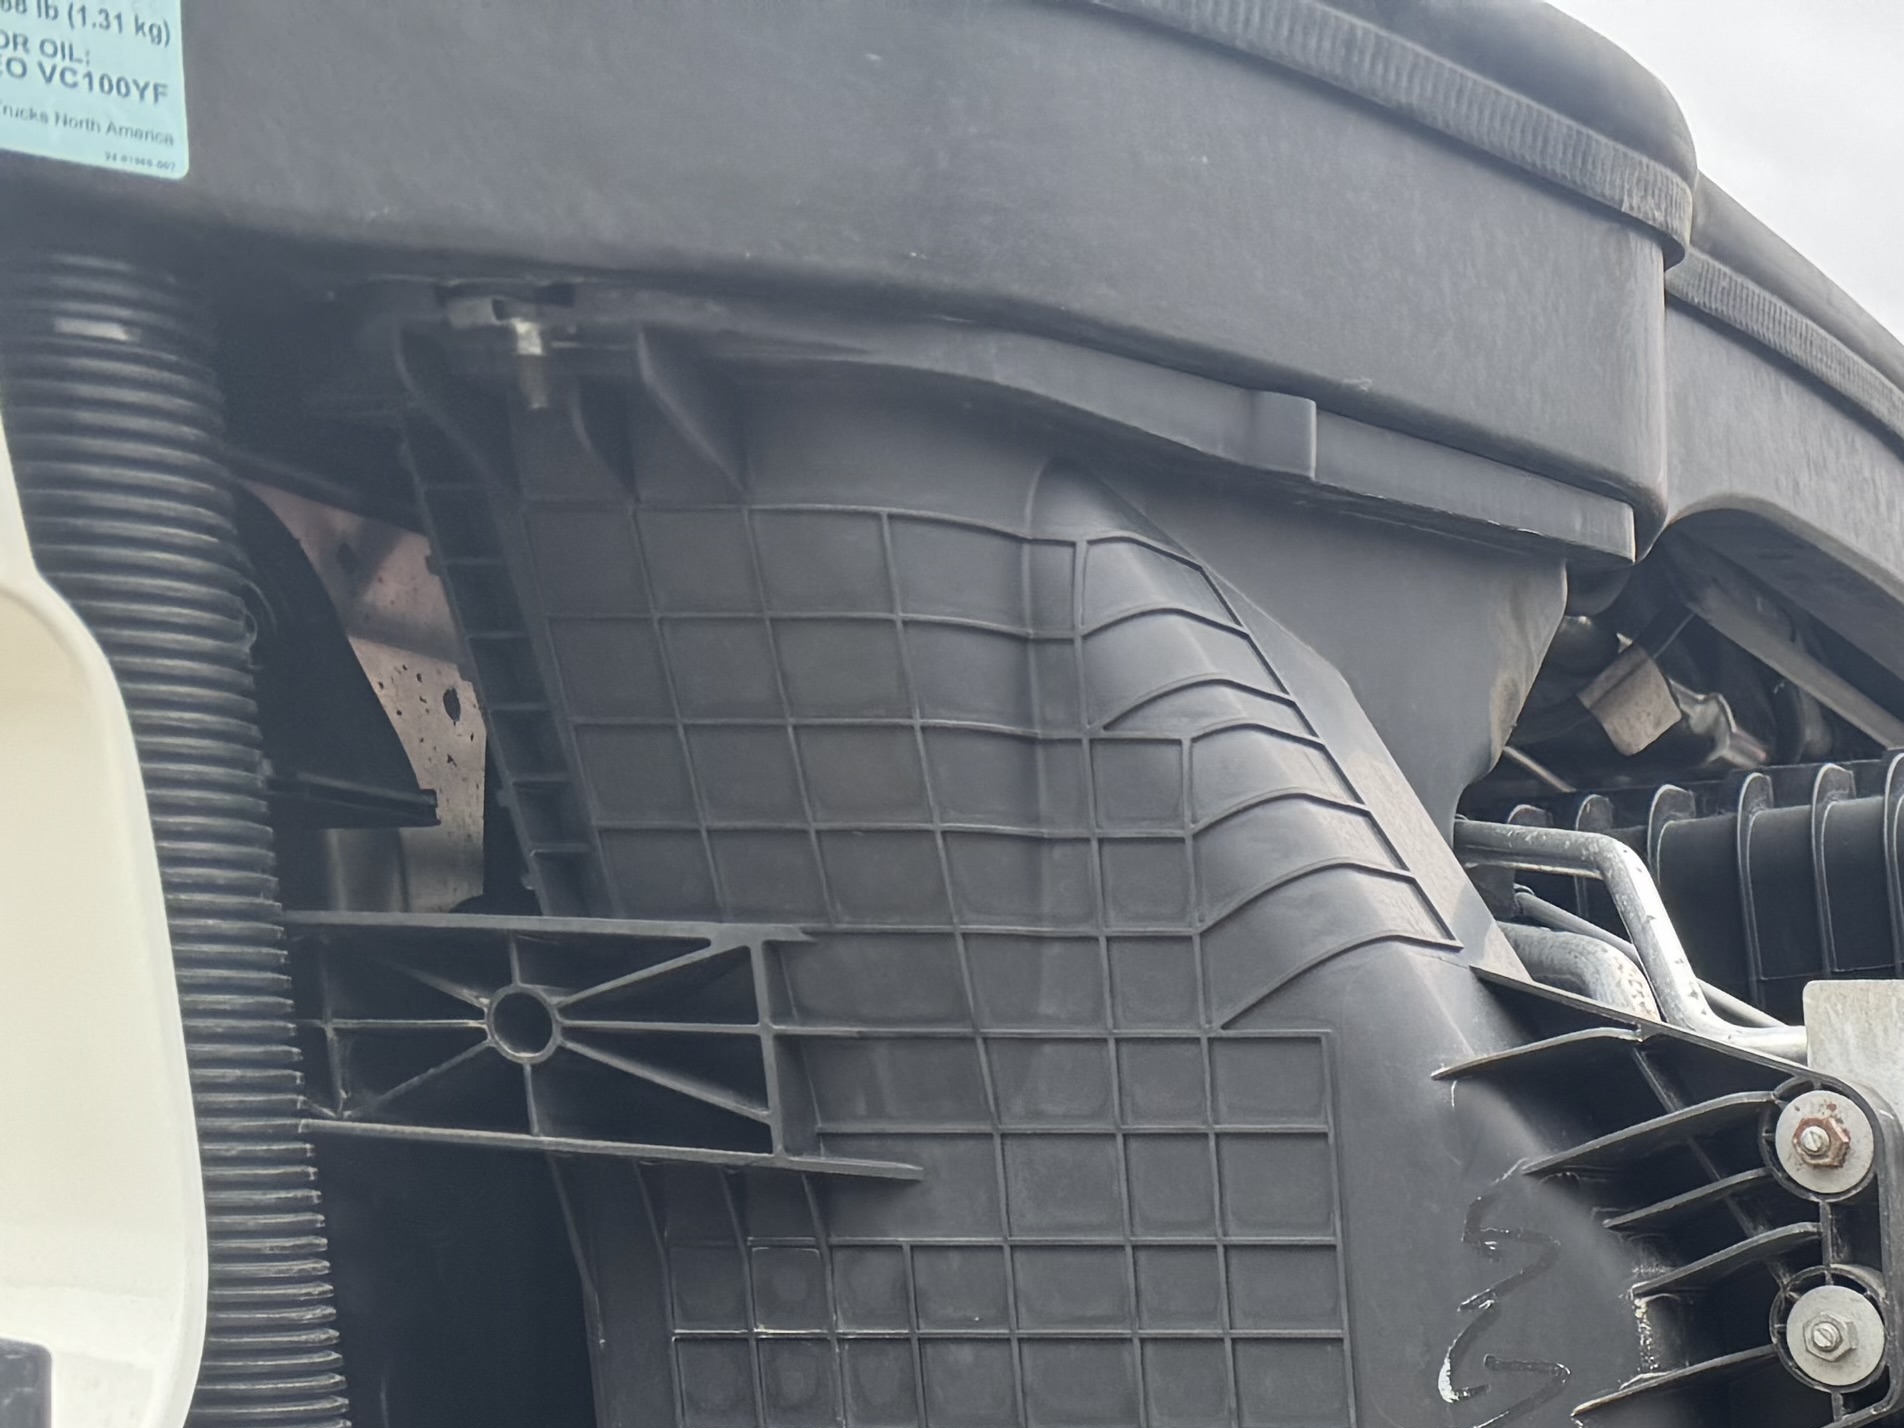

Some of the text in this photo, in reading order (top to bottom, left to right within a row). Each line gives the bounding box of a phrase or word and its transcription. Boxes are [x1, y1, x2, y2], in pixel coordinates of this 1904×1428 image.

[37, 0, 58, 20] lb
[68, 2, 123, 34] (1.31
[135, 15, 170, 47] kg)
[39, 38, 90, 66] OIL:
[38, 60, 168, 105] VC100YF
[54, 111, 101, 133] North
[105, 121, 174, 147] America
